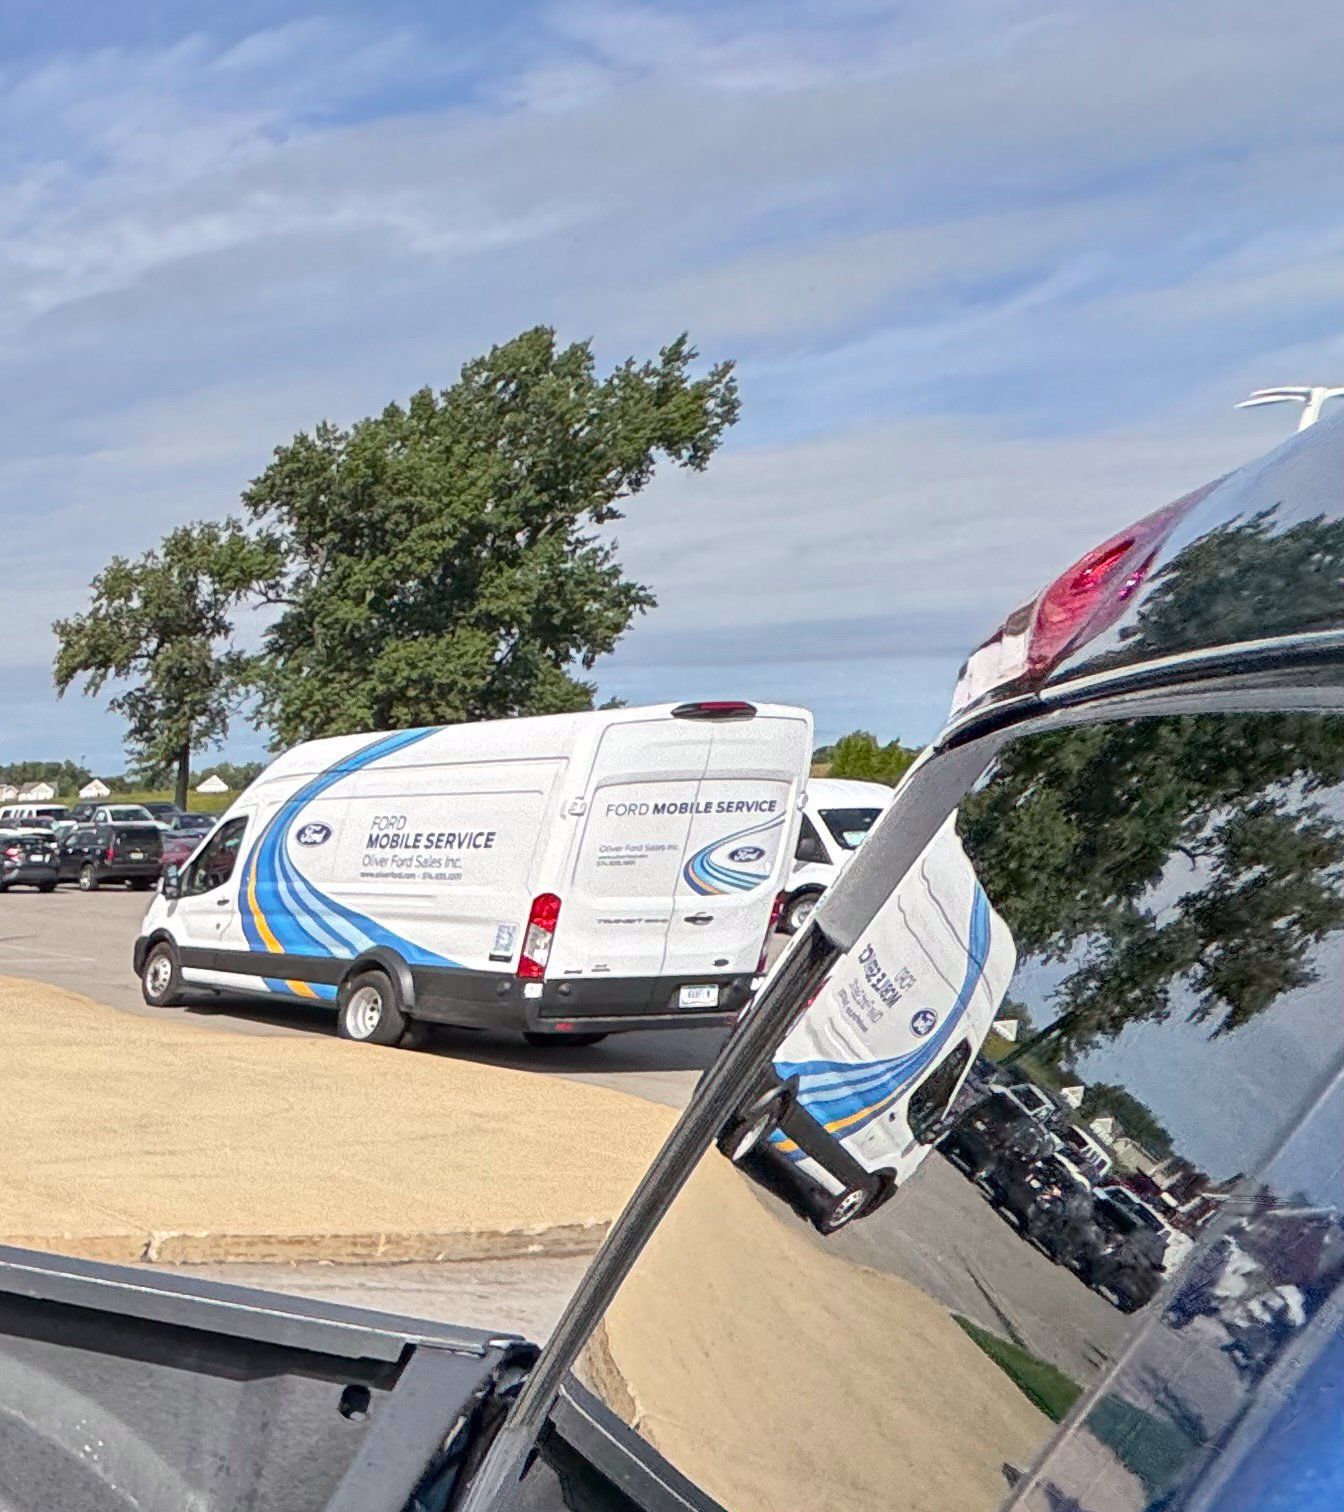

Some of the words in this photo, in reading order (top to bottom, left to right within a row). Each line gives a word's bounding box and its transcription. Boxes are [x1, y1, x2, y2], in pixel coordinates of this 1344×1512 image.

[606, 803, 650, 817] FORD
[652, 801, 713, 815] MOBILE
[717, 799, 778, 814] SERVICE
[370, 815, 408, 831] FORD
[365, 831, 424, 850] MOBILE
[425, 831, 497, 849] SERVICE
[362, 854, 389, 868] Oliver
[391, 854, 413, 868] Ford
[415, 854, 442, 869] Sales
[445, 854, 462, 869] Inc.
